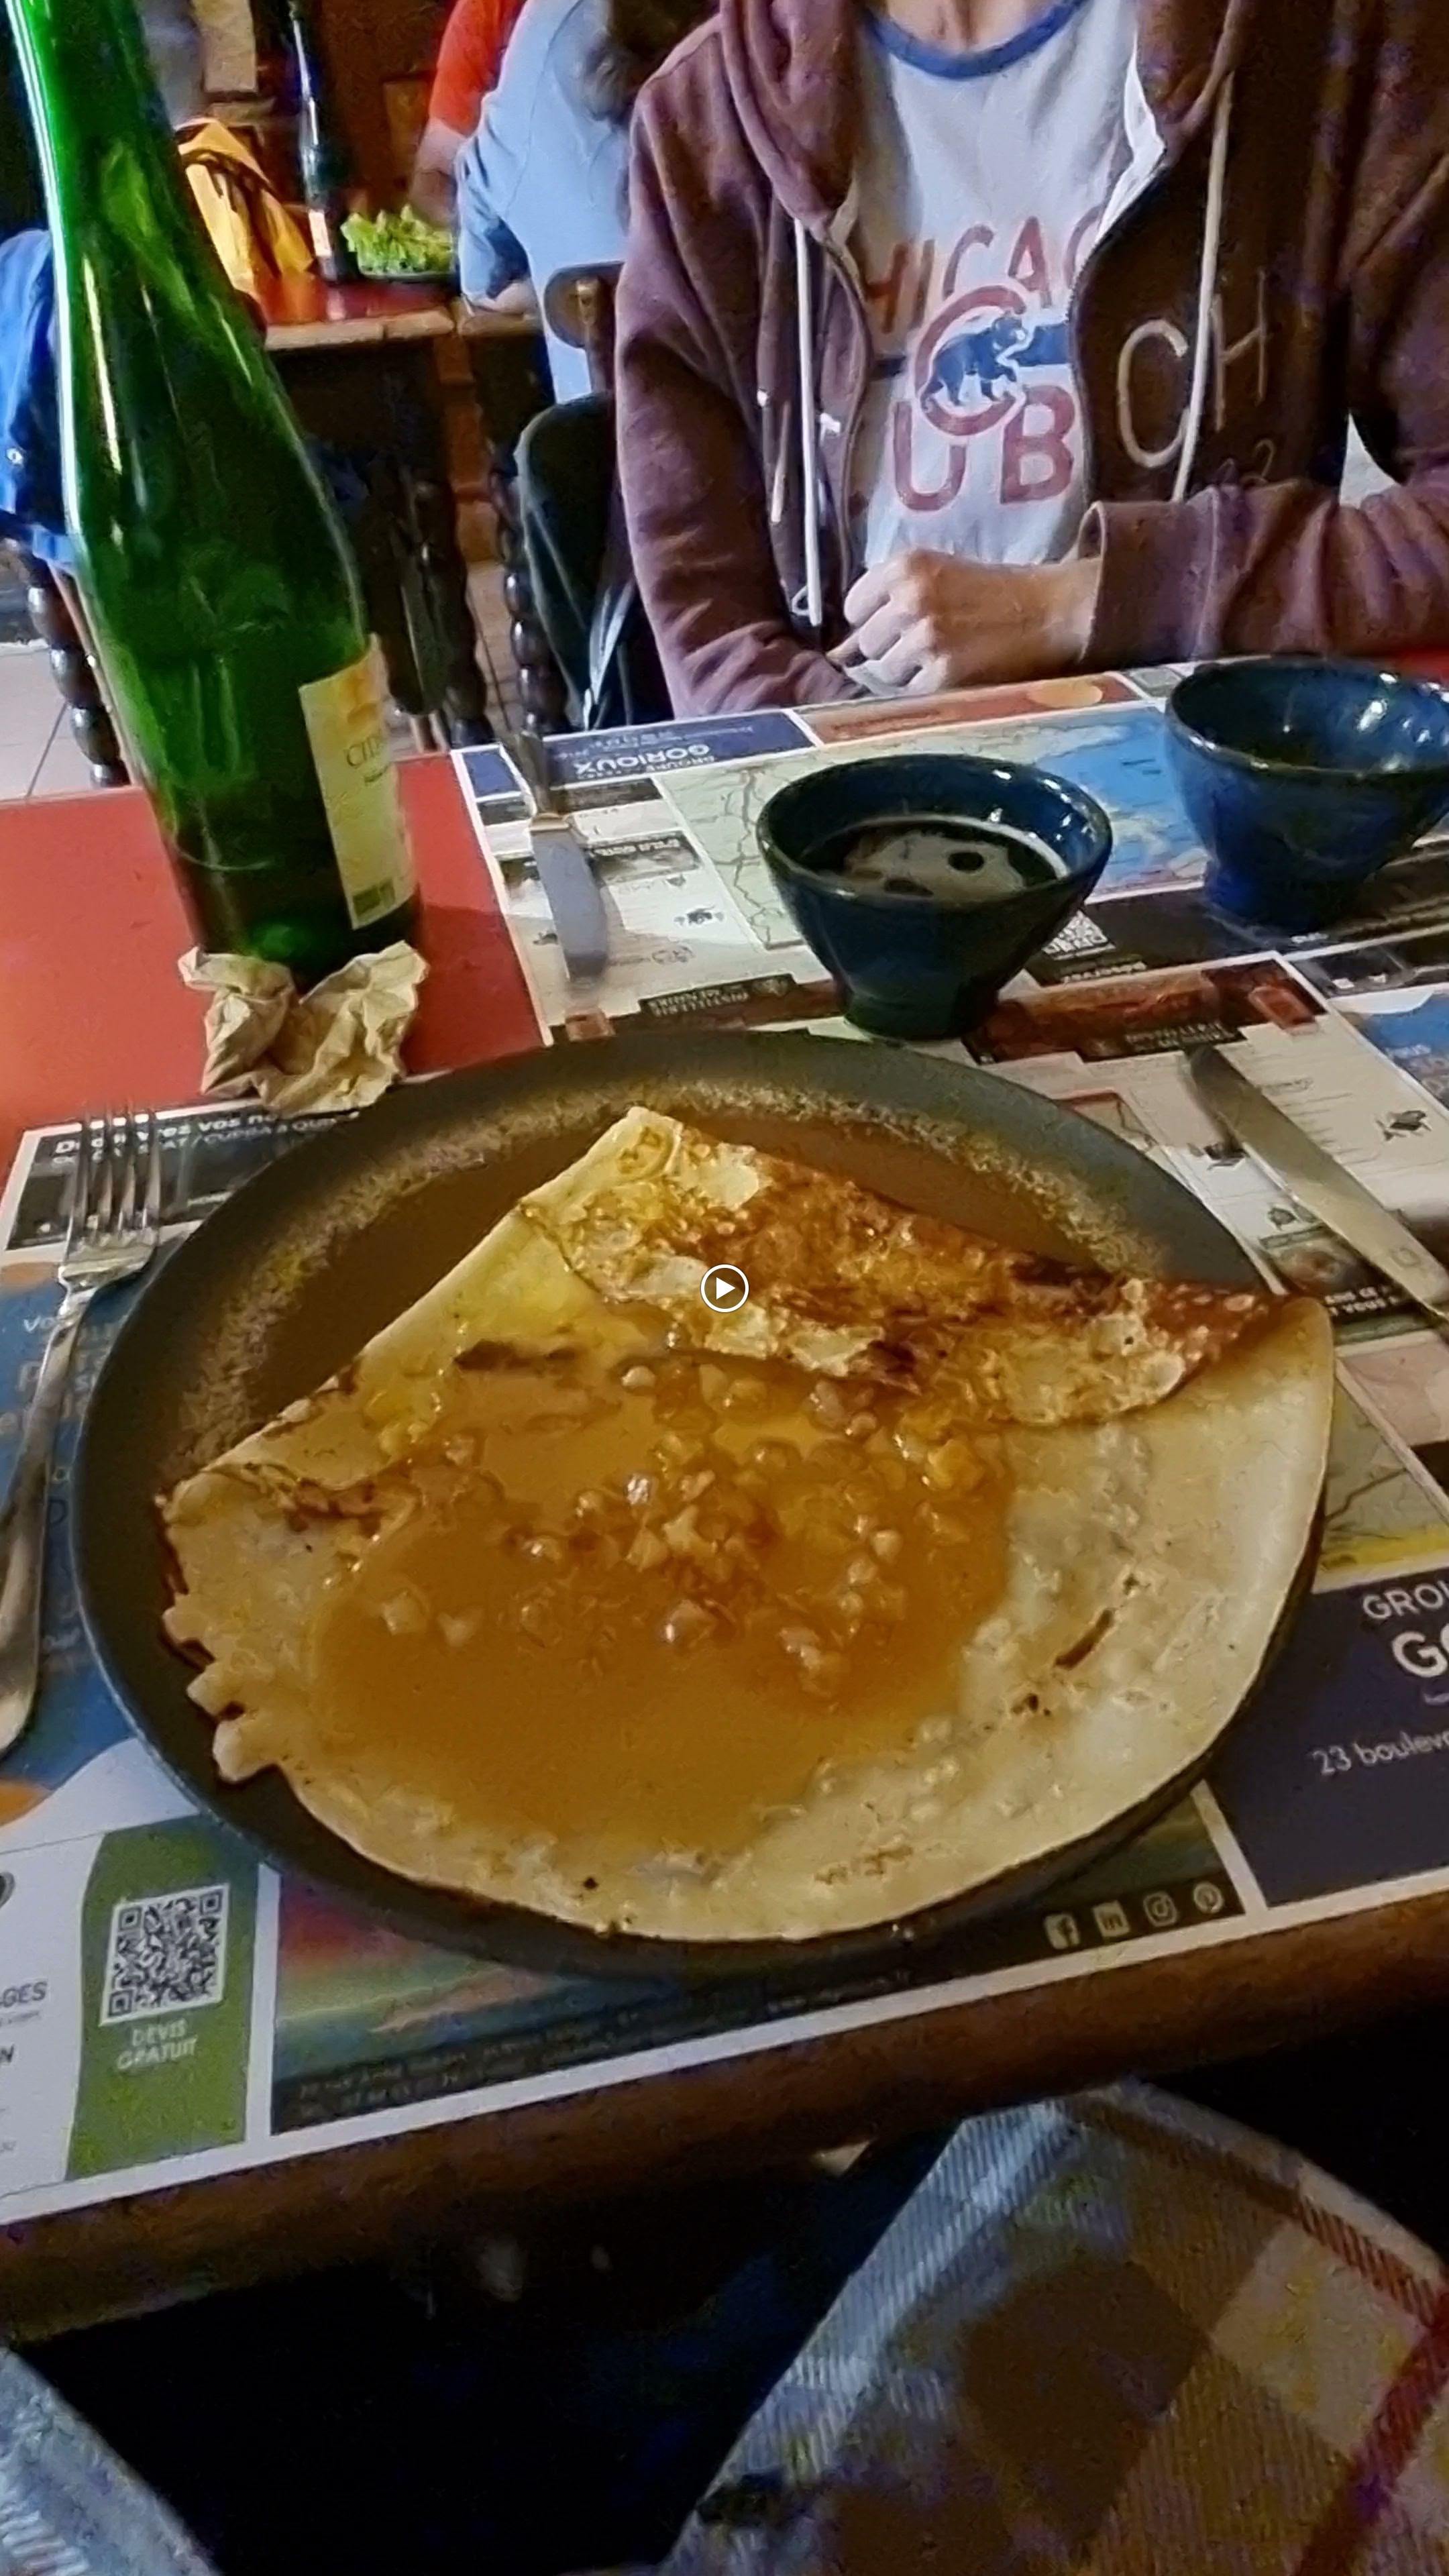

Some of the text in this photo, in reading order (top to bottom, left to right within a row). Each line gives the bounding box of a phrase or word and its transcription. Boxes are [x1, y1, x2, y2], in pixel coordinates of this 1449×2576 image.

[574, 744, 710, 774] GORIOUX
[1312, 1746, 1352, 1776] 23
[132, 2018, 187, 2046] DEVIS
[117, 2034, 199, 2070] GRATUIT
